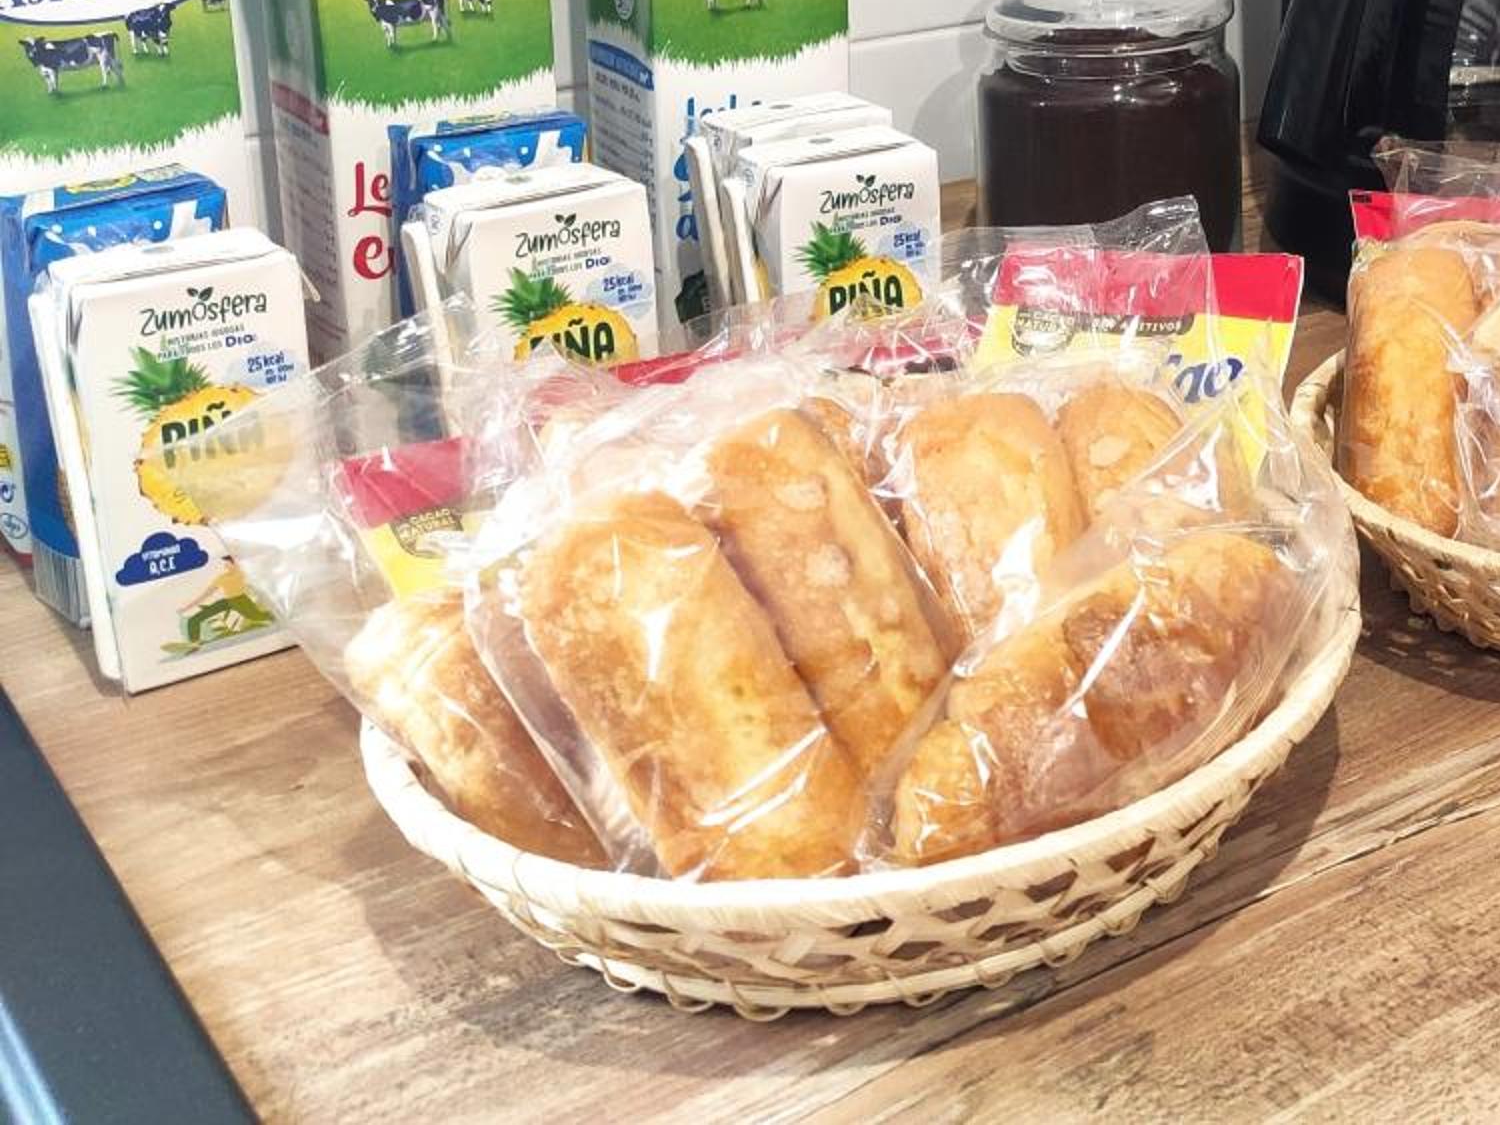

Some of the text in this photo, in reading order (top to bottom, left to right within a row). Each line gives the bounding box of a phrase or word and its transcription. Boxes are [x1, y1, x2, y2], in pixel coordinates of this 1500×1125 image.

[819, 181, 915, 215] Zumosfera
[514, 217, 621, 259] Zumosfera
[140, 291, 268, 337] Zumosfera
[829, 270, 904, 316] PIÑA
